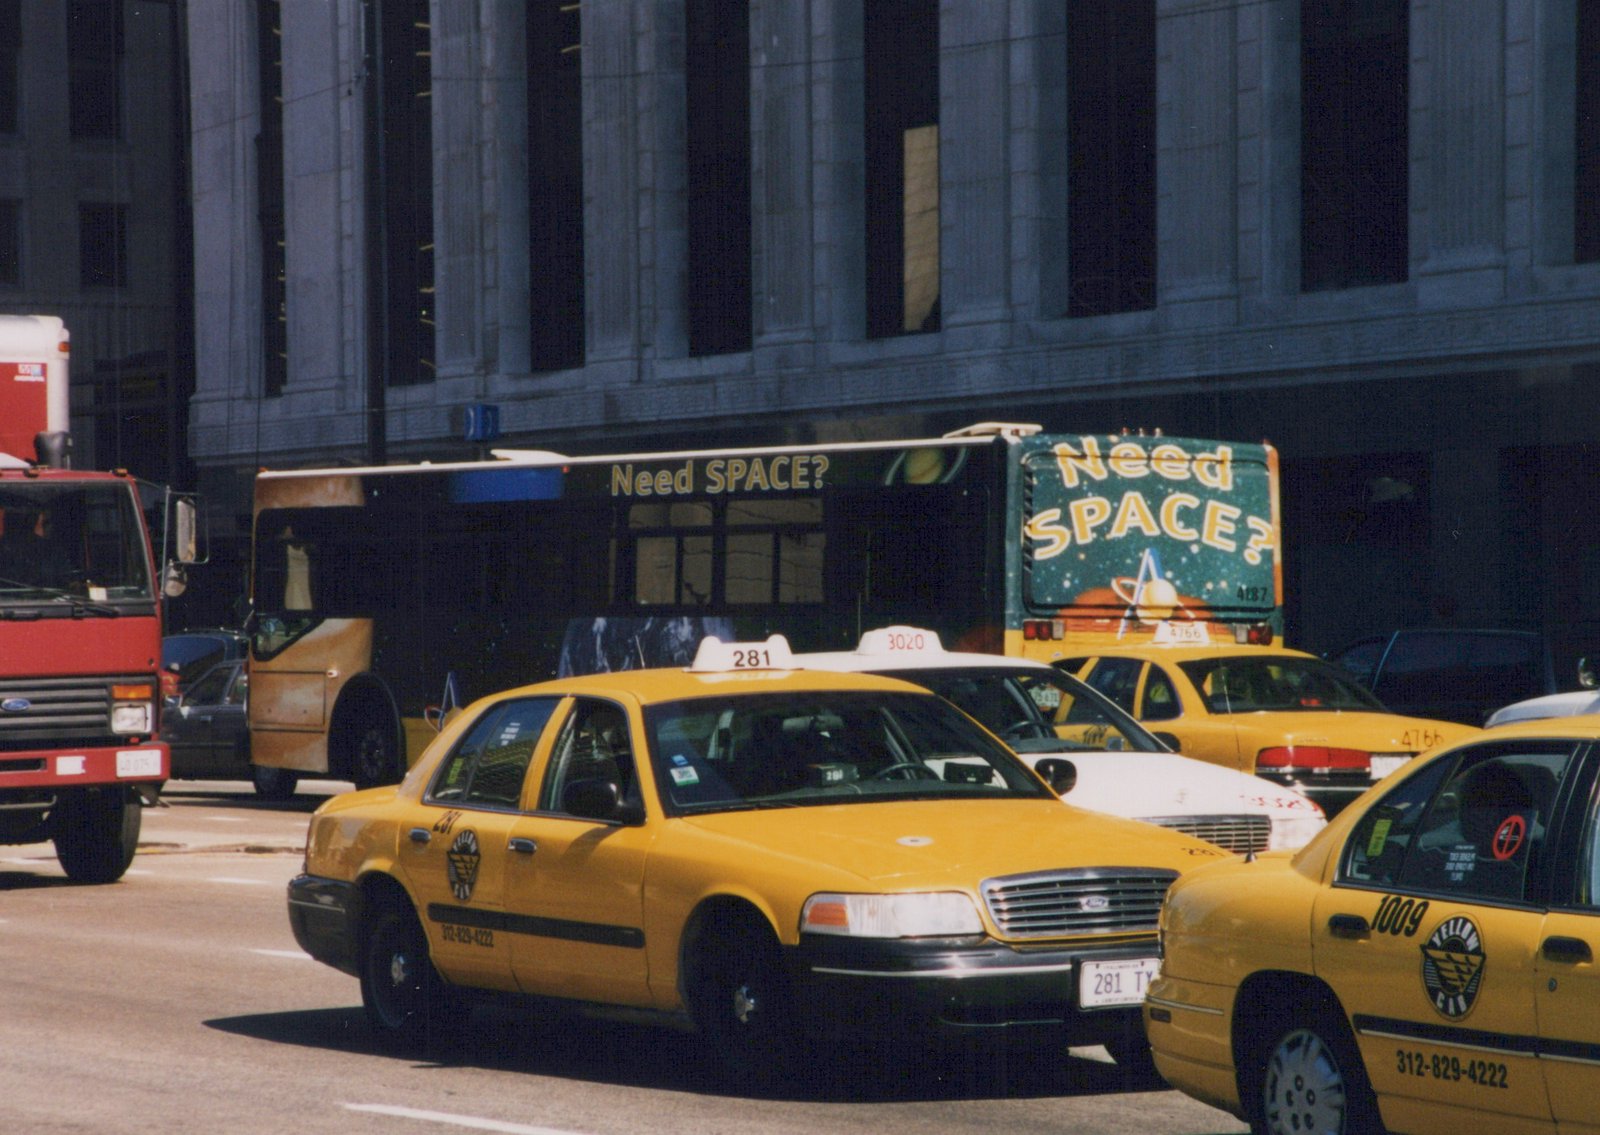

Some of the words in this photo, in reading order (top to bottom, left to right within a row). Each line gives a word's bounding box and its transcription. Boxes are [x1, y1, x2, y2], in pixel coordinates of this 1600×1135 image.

[611, 459, 694, 496] Need
[705, 454, 829, 494] SPACE?
[1053, 435, 1233, 491] Need
[1024, 491, 1273, 565] SPACE?
[733, 649, 770, 667] 281
[888, 633, 924, 650] 3020
[1370, 895, 1429, 937] 1009
[1431, 918, 1480, 951] YELLOW
[1094, 972, 1122, 995] 281
[1436, 991, 1468, 1015] CAB
[1396, 1049, 1509, 1089] 312-829-4222
